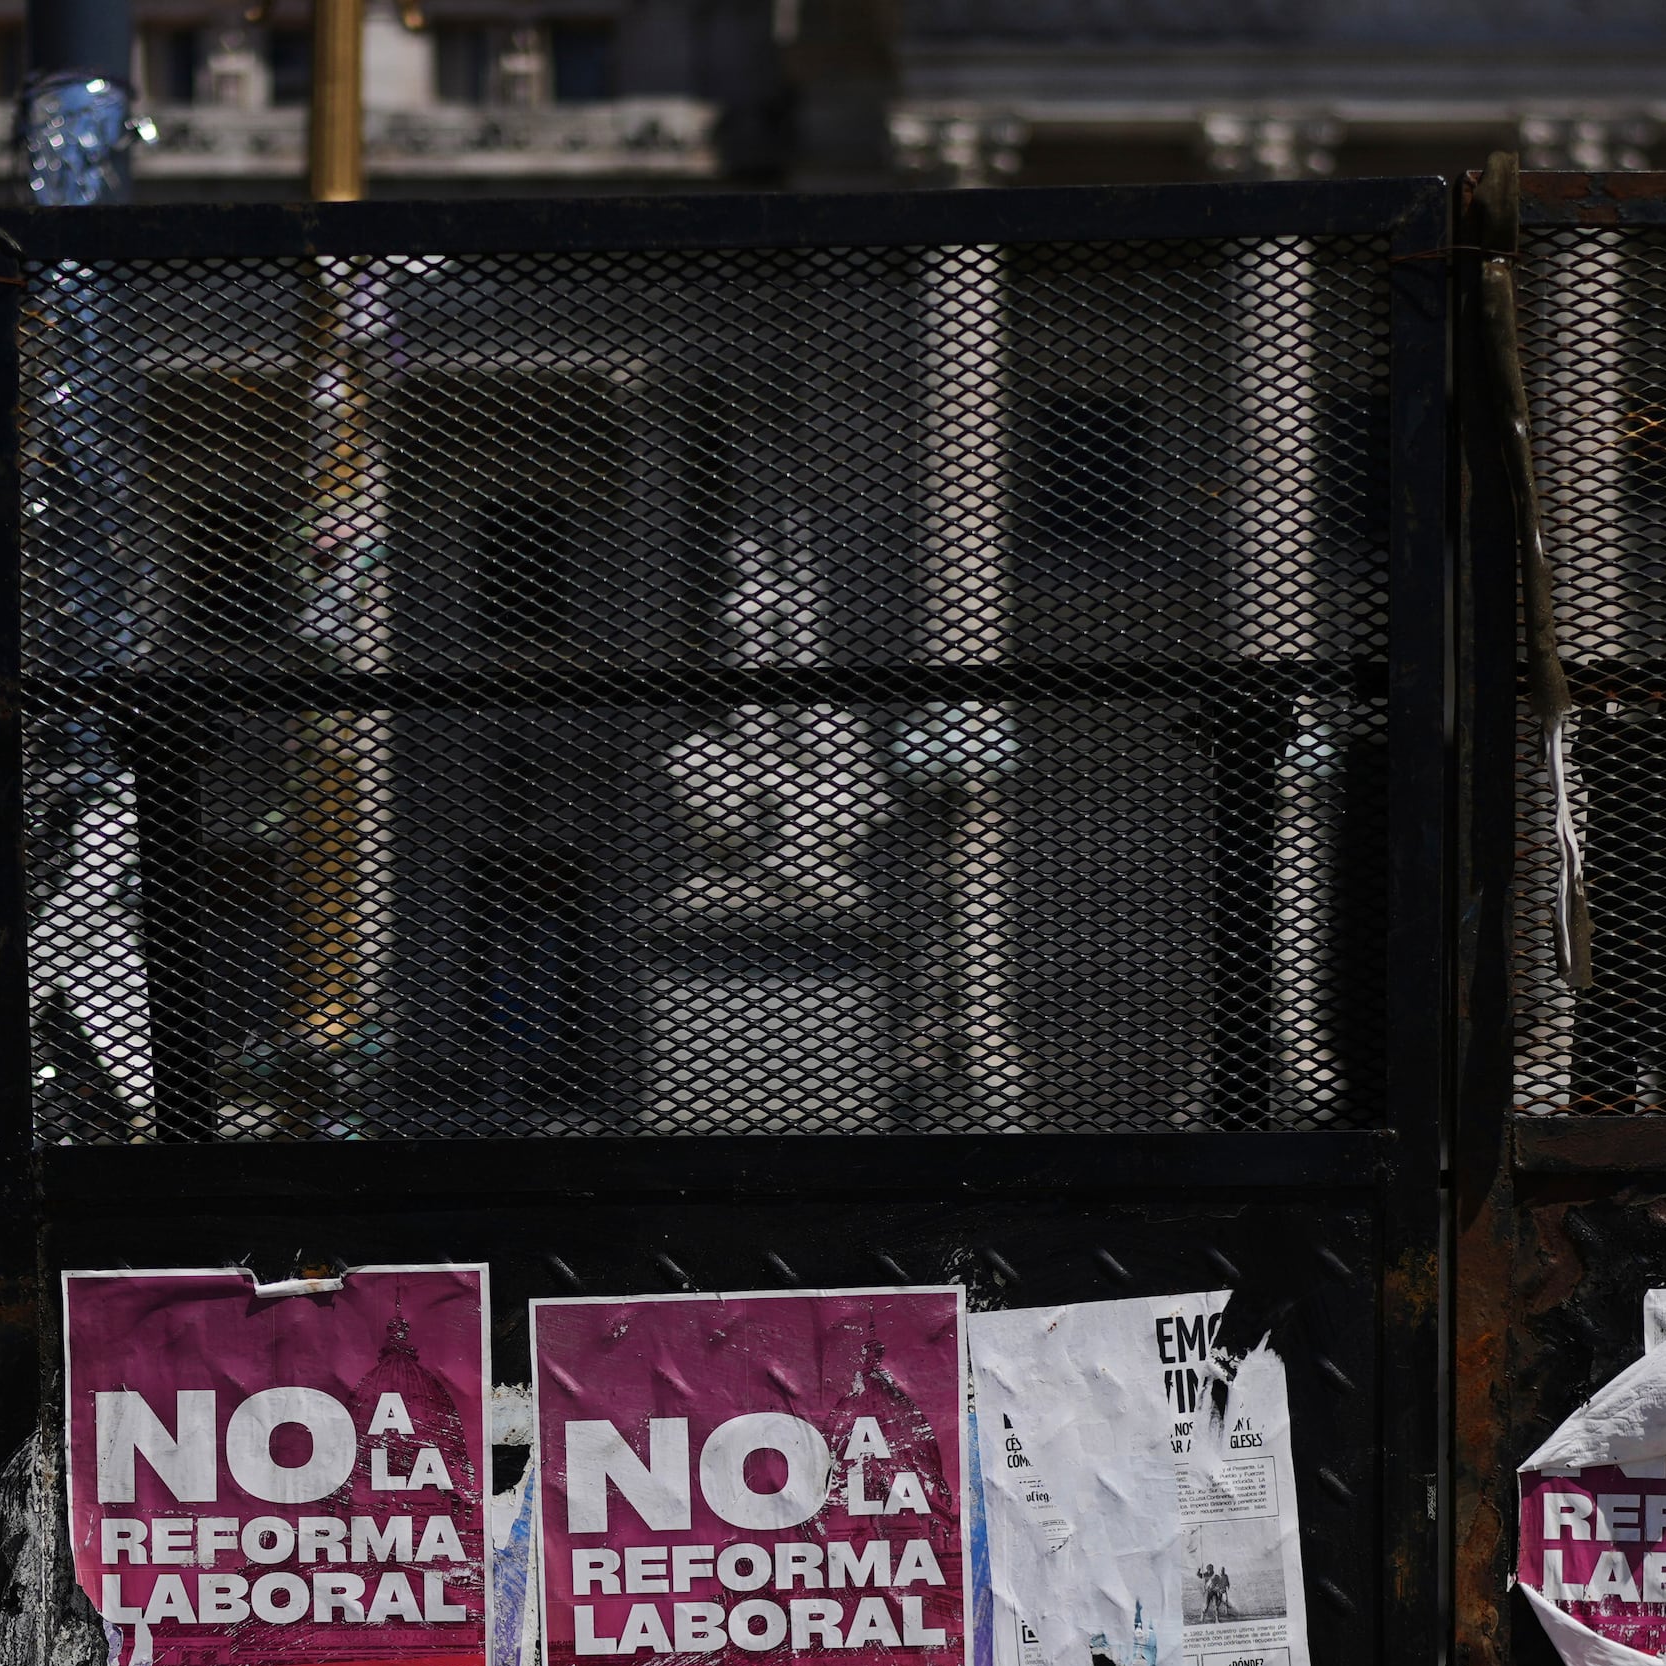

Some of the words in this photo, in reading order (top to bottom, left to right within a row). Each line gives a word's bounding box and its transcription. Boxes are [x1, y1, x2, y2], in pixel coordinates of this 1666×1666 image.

[94, 1386, 357, 1504] NO
[368, 1392, 415, 1435] A
[370, 1448, 453, 1491] LA
[564, 1412, 831, 1535] NO
[842, 1417, 890, 1459] A
[847, 1473, 931, 1517] LA
[100, 1515, 466, 1566] REFORMA
[572, 1540, 944, 1595] REFORMA
[102, 1572, 466, 1625] LABORAL
[574, 1598, 946, 1656] LABORAL
